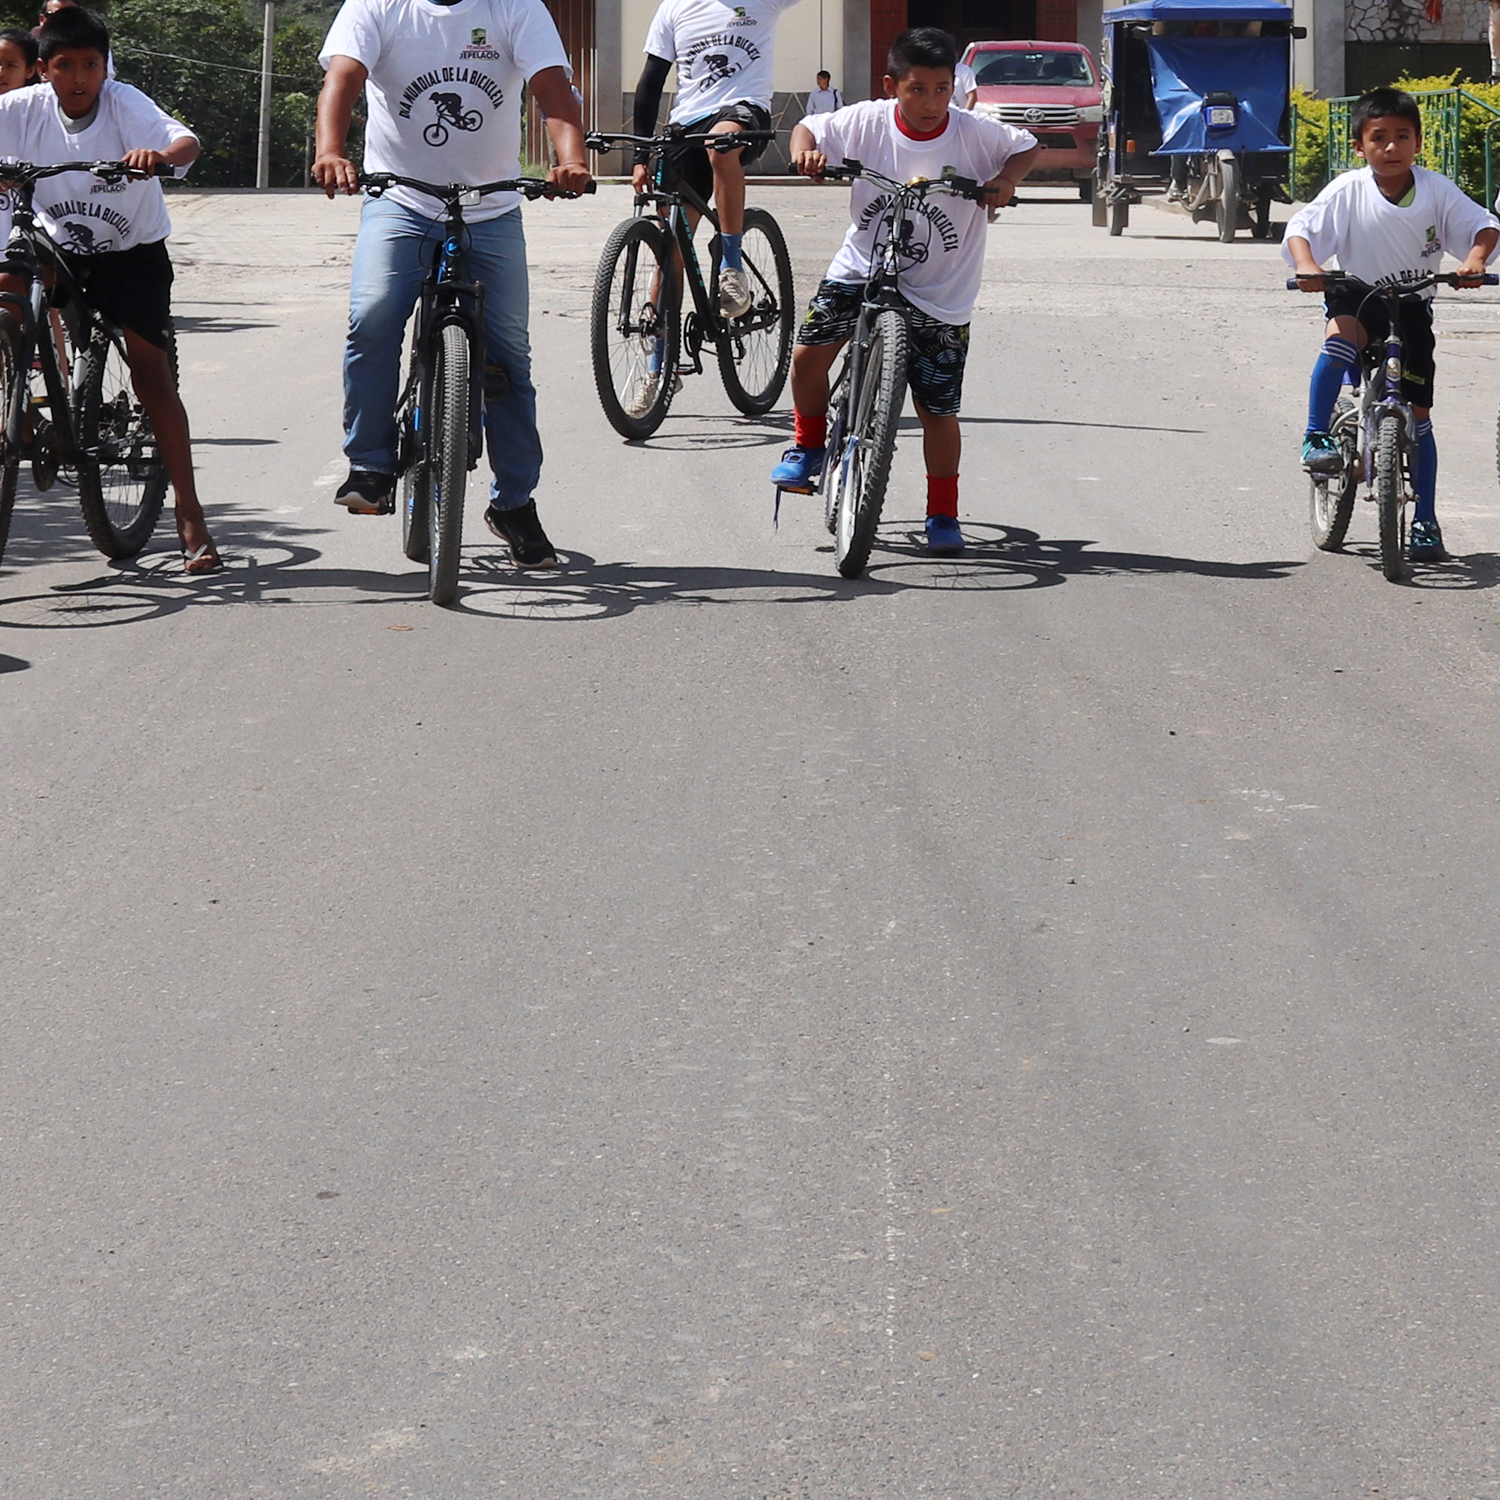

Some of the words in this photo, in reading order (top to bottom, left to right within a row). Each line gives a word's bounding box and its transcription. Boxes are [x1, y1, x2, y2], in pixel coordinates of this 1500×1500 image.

[458, 49, 500, 60] JEPELACIO
[442, 66, 454, 82] DE
[456, 66, 469, 83] LA
[403, 69, 442, 106] MUNDIAL
[469, 70, 504, 110] BICICLETA
[399, 100, 414, 119] DIA
[88, 202, 102, 219] LA
